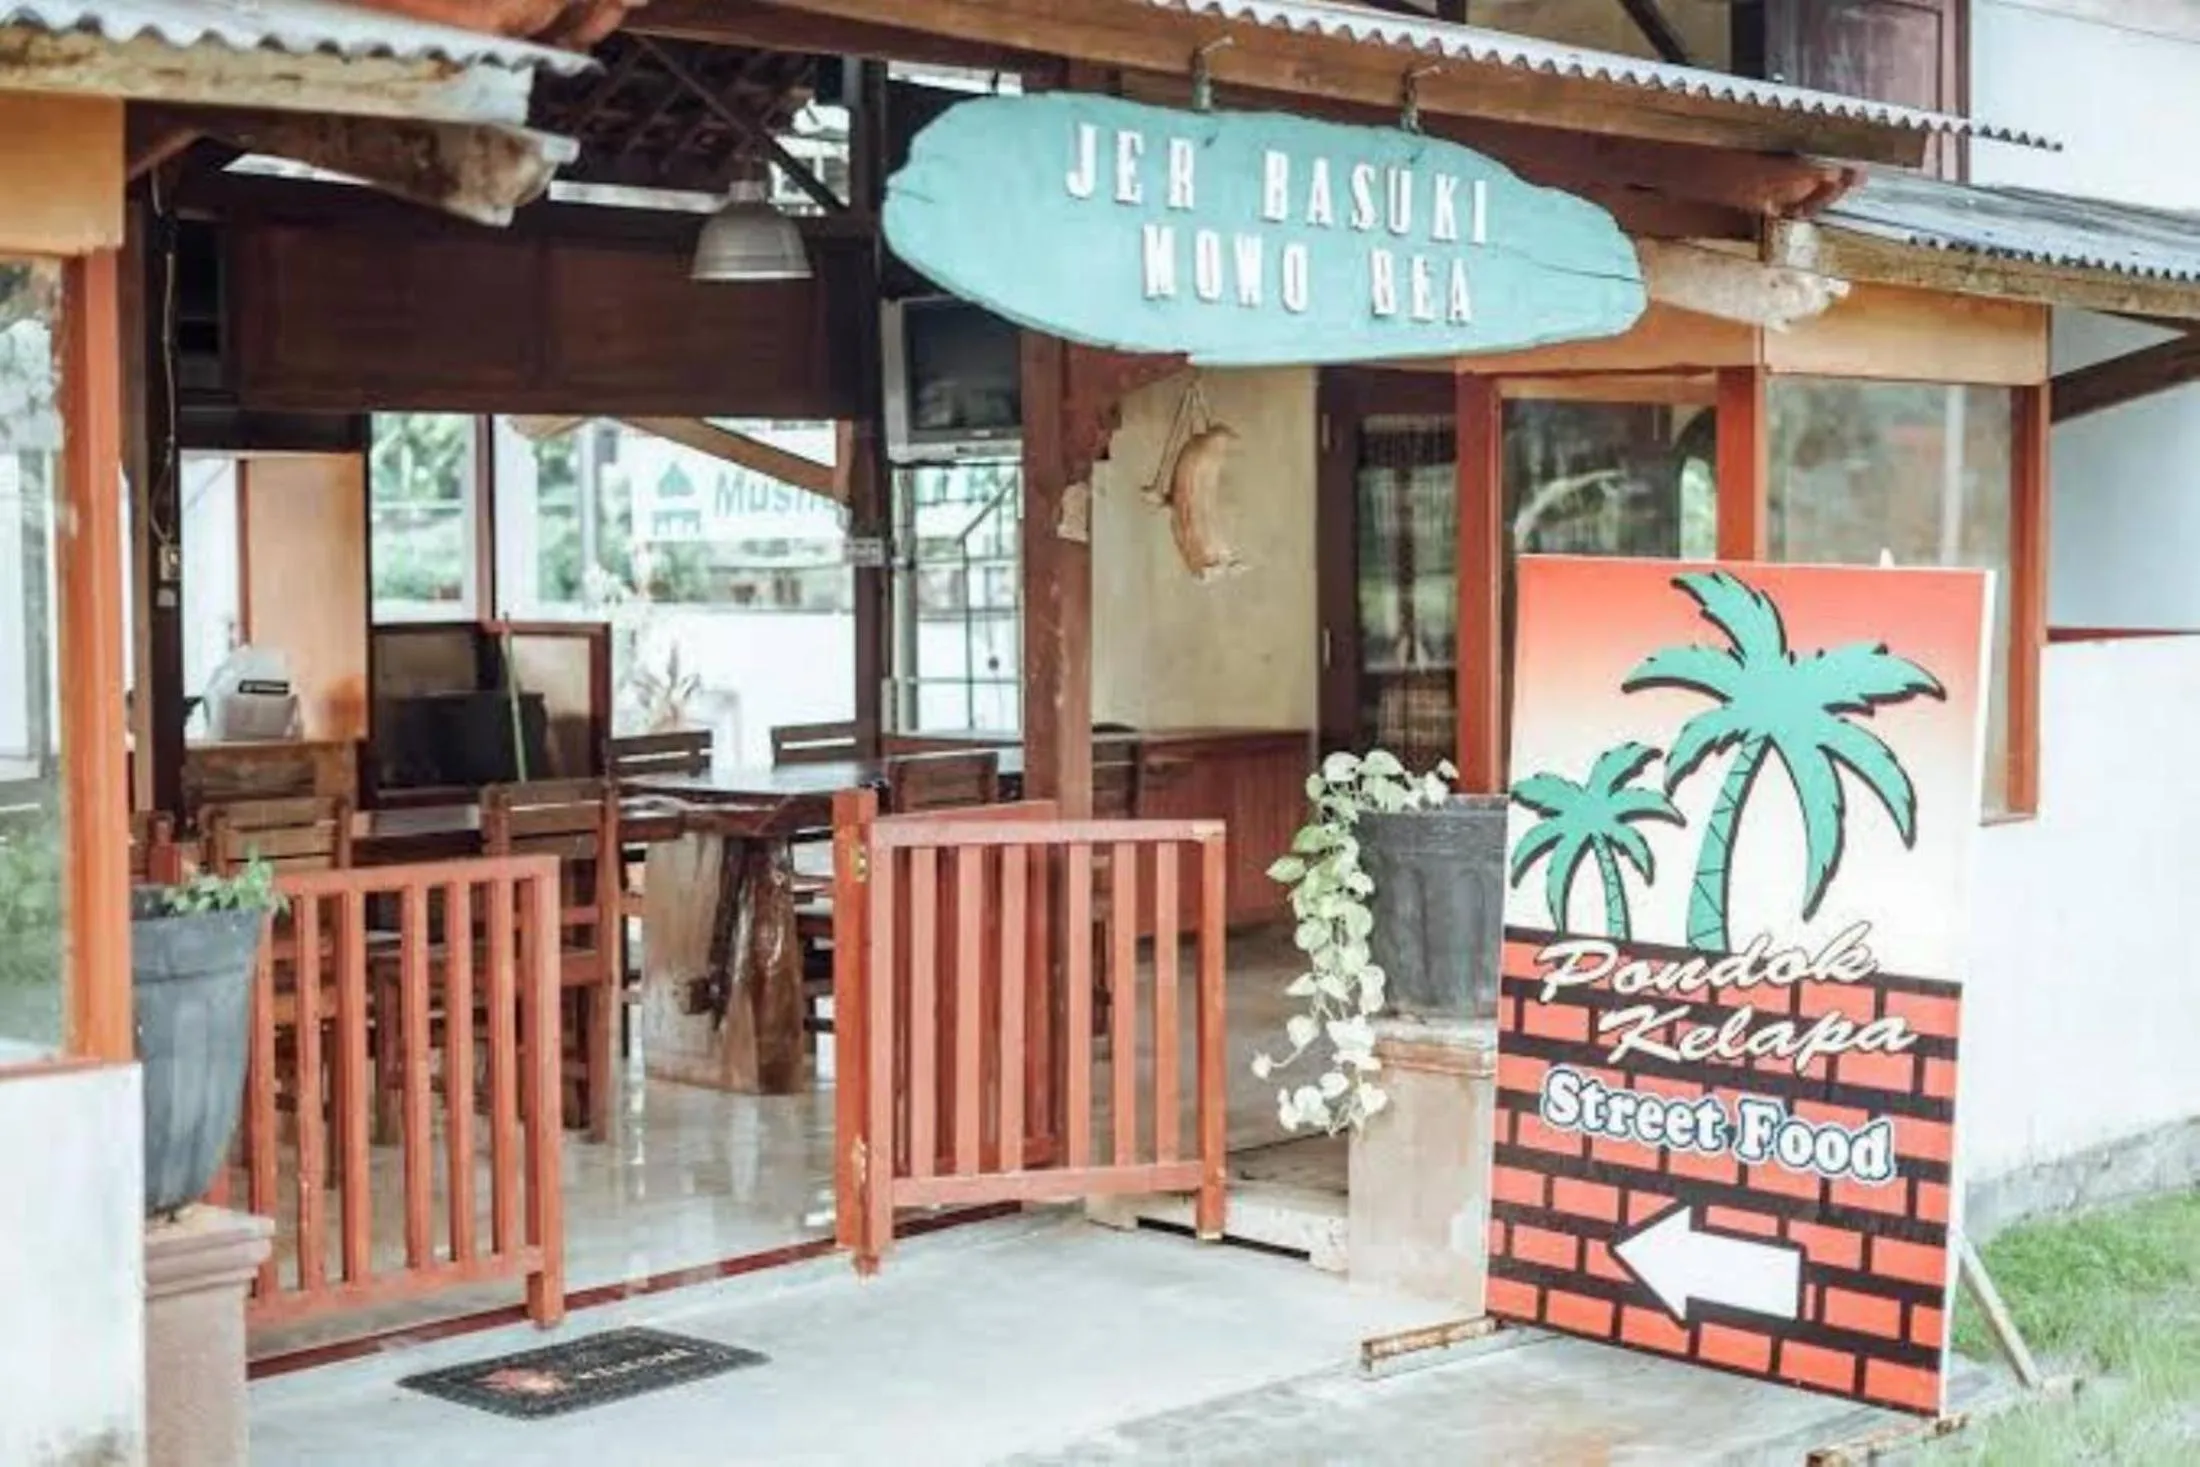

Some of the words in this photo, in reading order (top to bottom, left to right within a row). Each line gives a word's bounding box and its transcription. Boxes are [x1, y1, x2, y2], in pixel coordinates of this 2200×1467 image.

[1066, 123, 1195, 210] JER
[1262, 150, 1487, 245] BASUKI
[1142, 222, 1308, 313] MOWO
[1371, 247, 1472, 323] BEA
[1535, 920, 1879, 1002] Pondok
[1599, 1003, 1918, 1075] Kelapa
[1543, 1066, 1728, 1152] Street
[1734, 1096, 1894, 1182] Food
